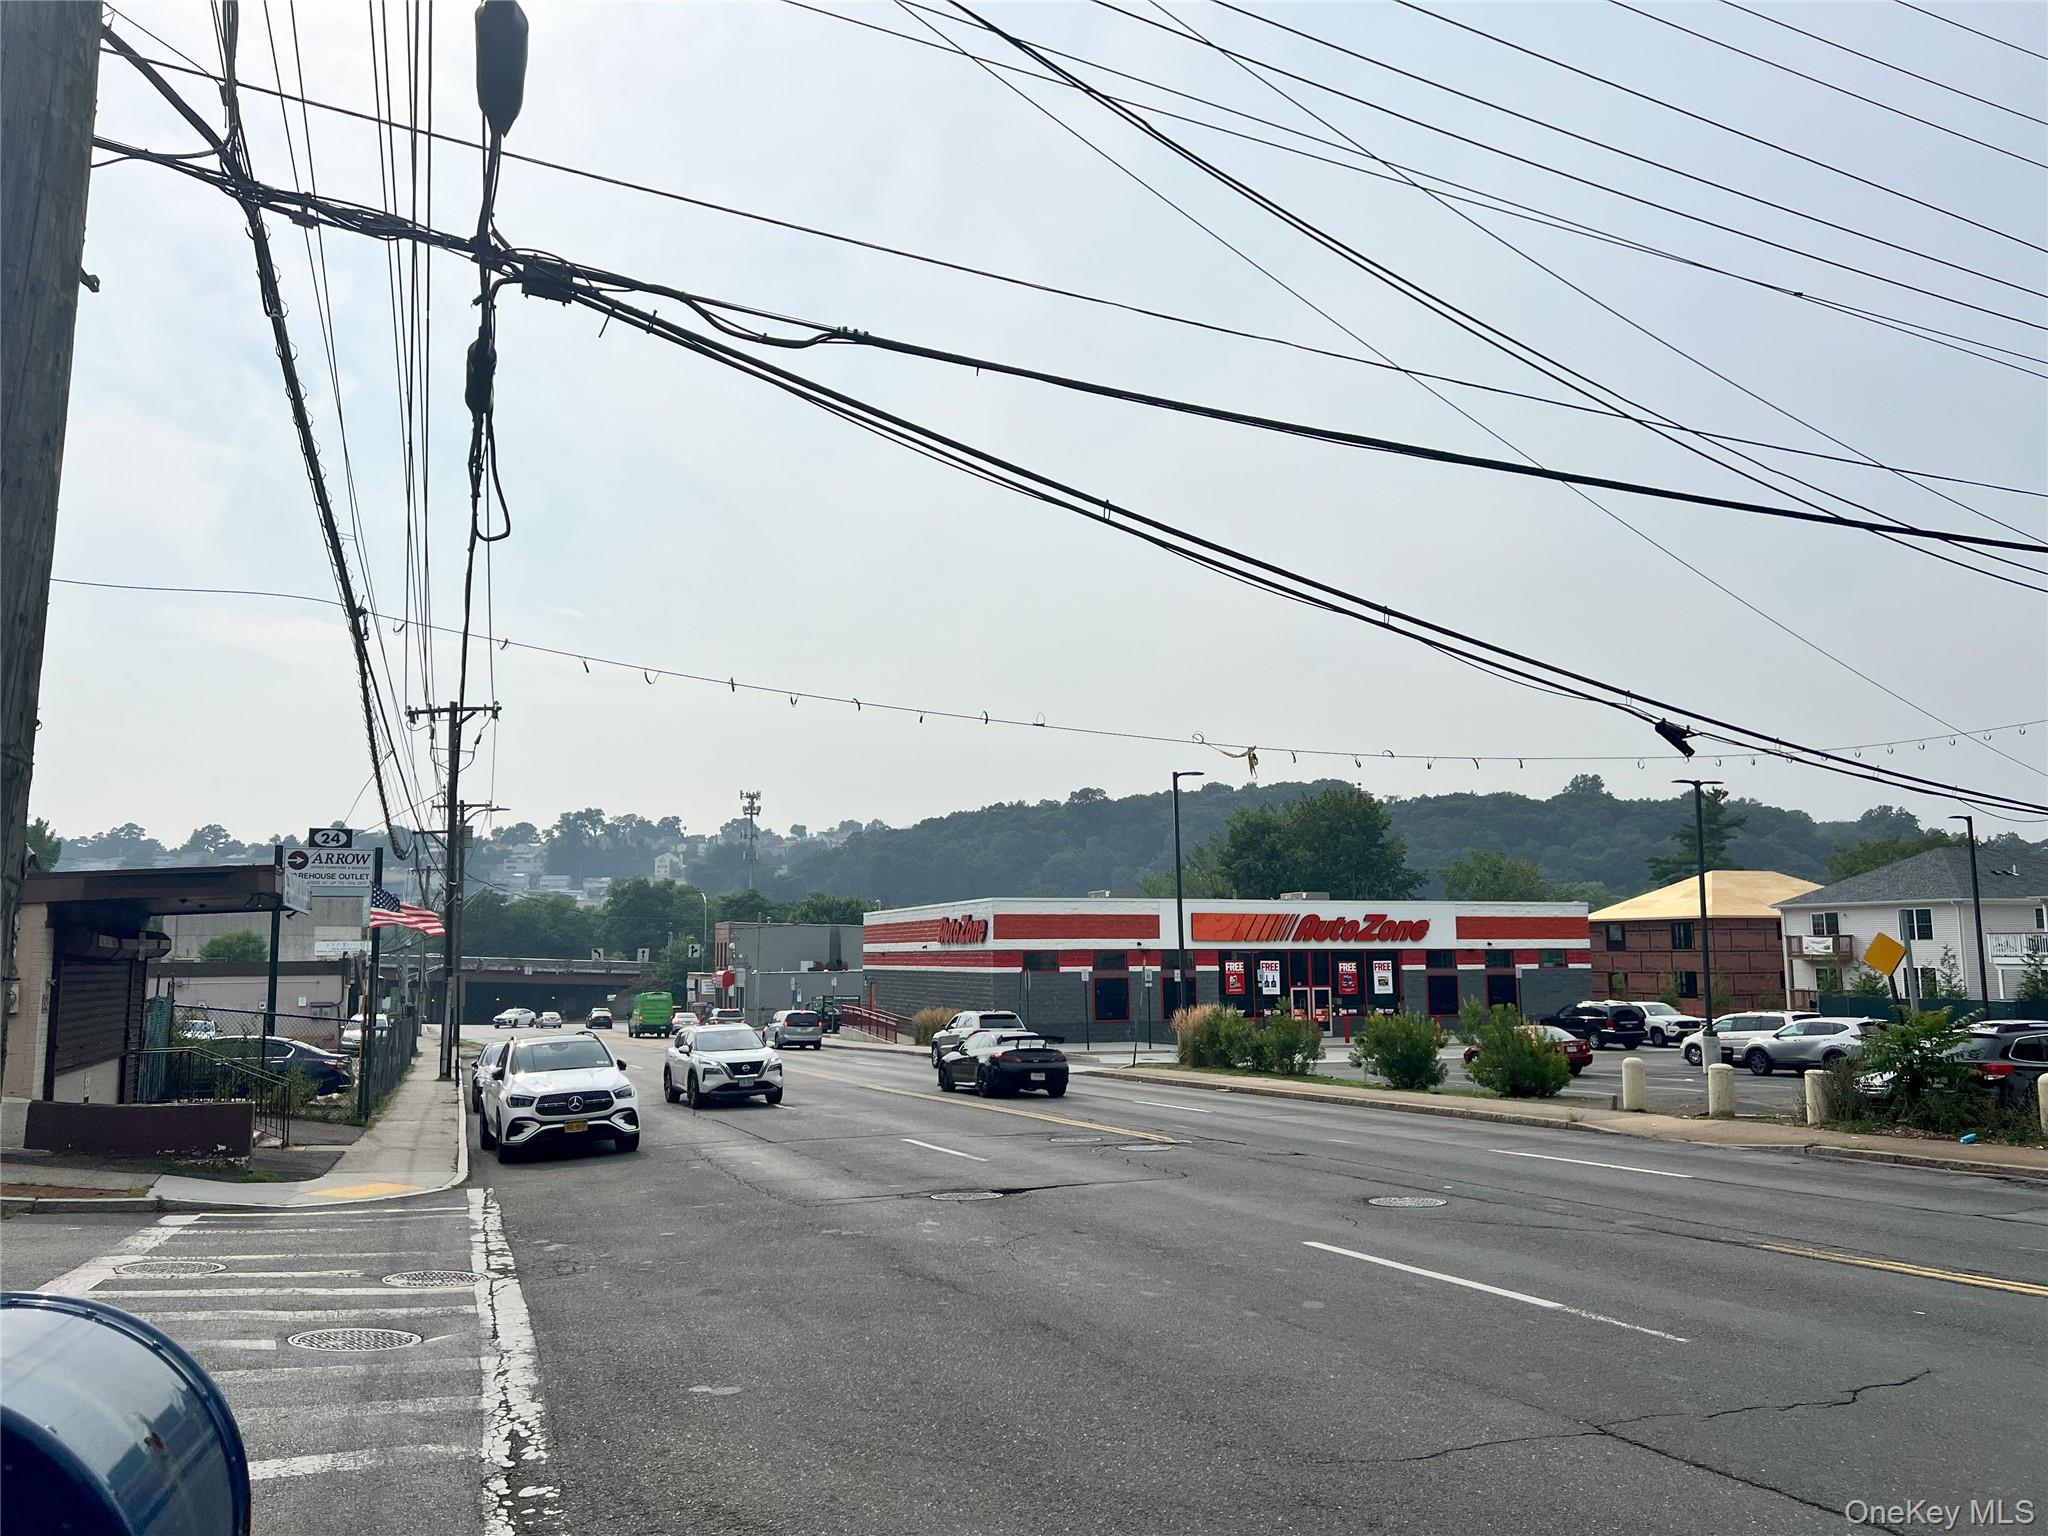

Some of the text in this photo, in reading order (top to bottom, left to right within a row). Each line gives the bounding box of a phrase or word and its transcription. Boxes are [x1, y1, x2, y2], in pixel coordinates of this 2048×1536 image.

[321, 832, 341, 844] 24
[312, 853, 371, 865] ARROW
[938, 914, 988, 944] AutoZone
[1292, 913, 1430, 943] AutoZone
[1225, 962, 1244, 972] FREE
[1261, 962, 1279, 971] FREE
[1339, 962, 1357, 971] FREE
[1374, 962, 1391, 971] FREE
